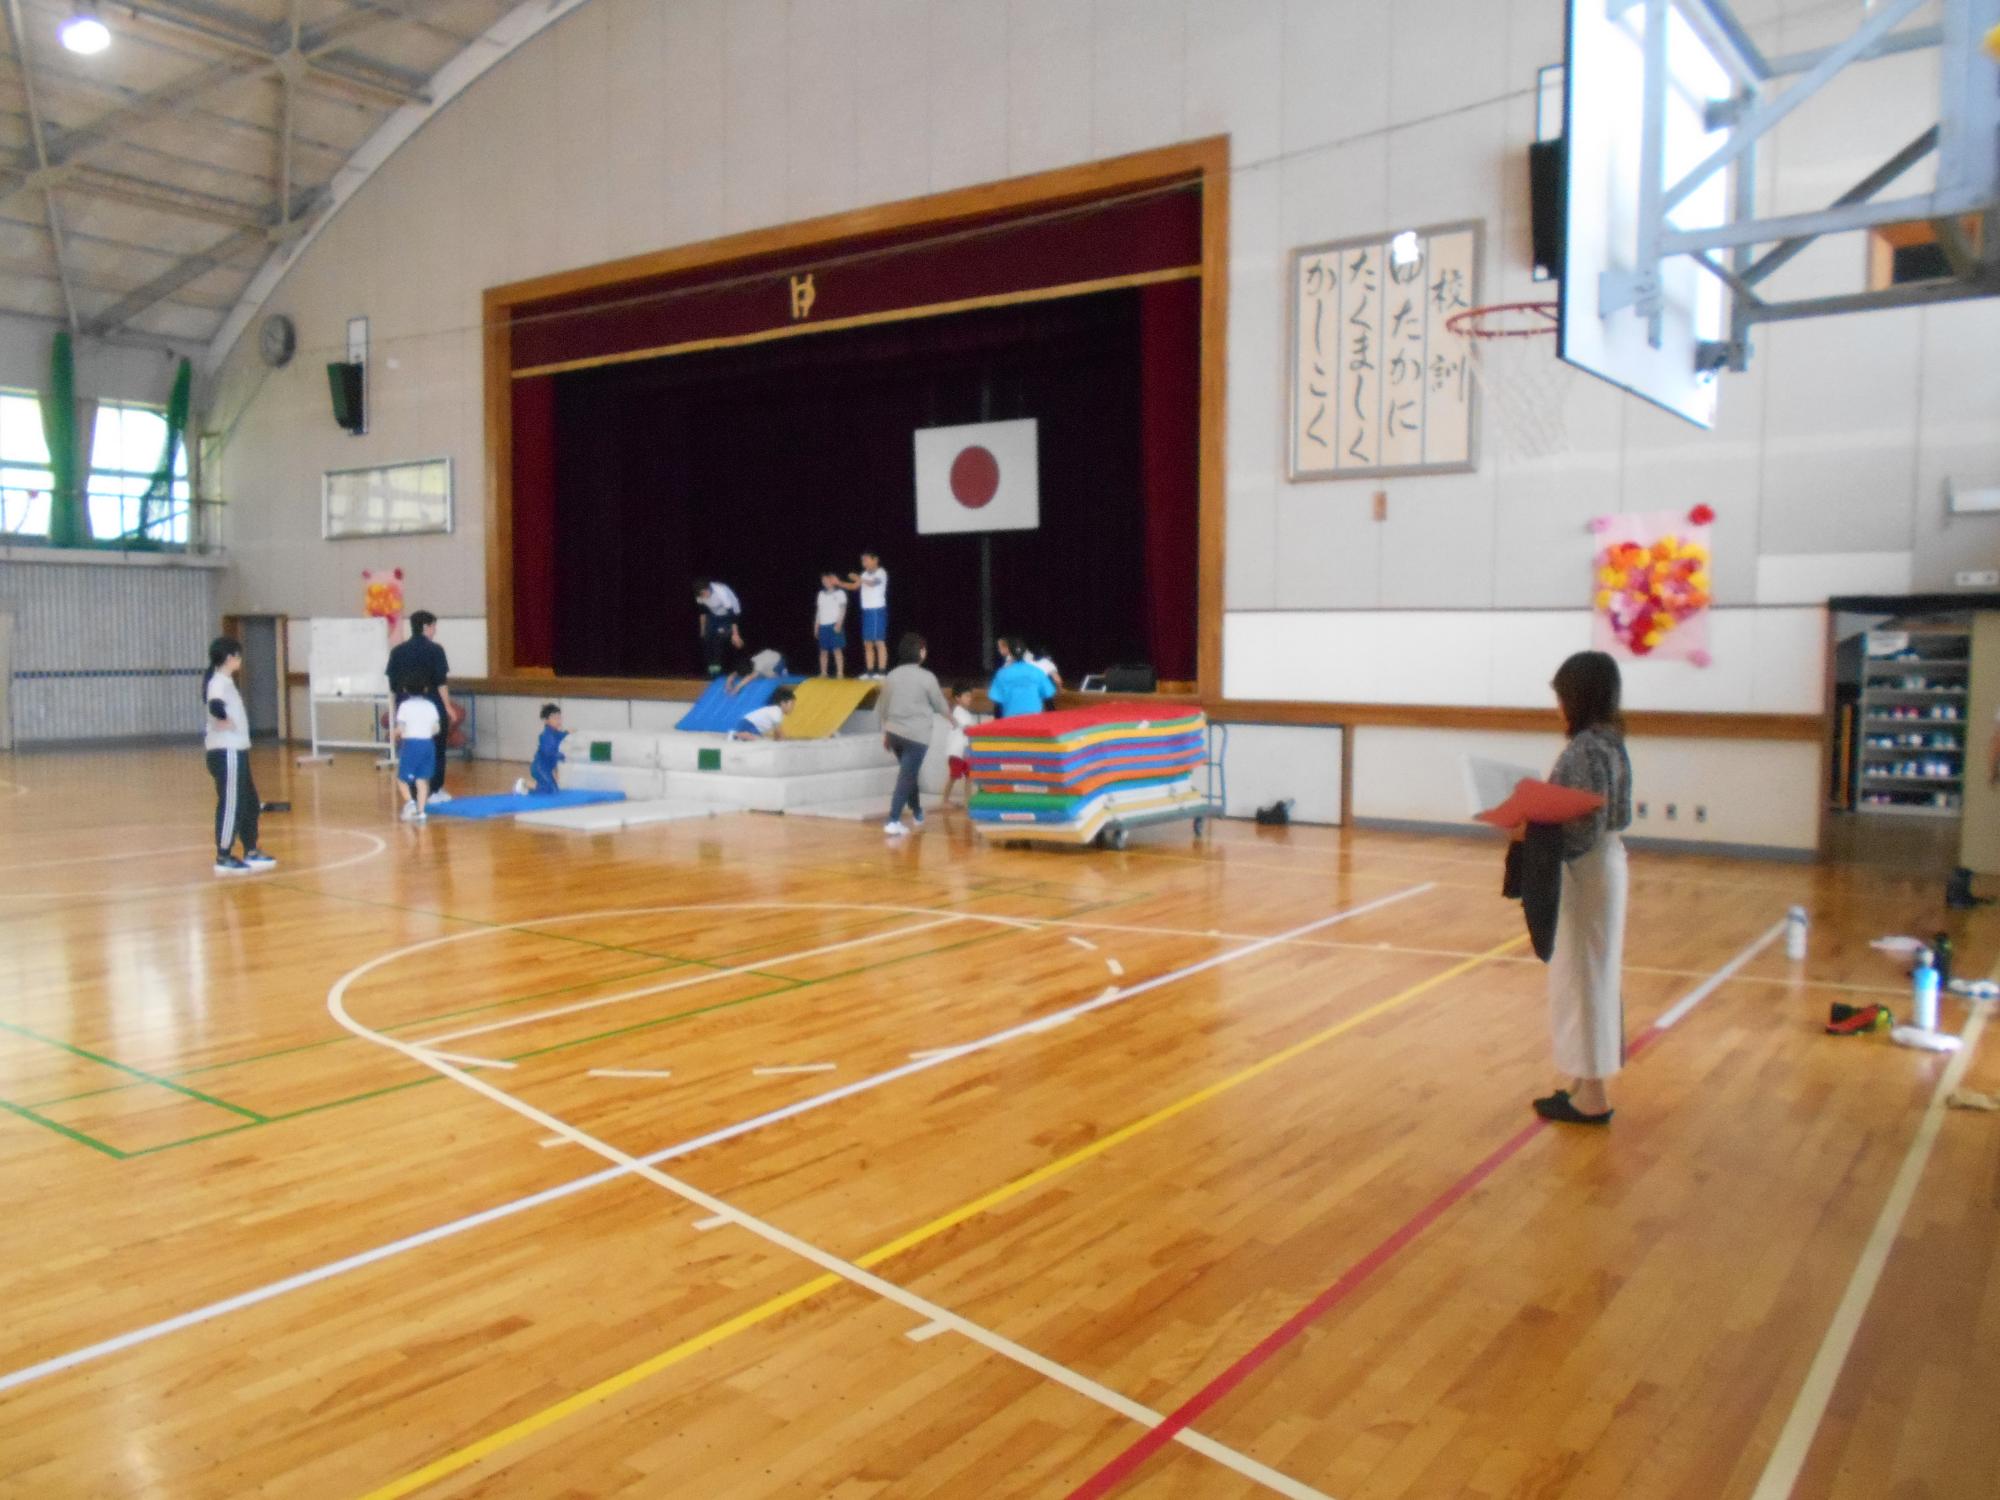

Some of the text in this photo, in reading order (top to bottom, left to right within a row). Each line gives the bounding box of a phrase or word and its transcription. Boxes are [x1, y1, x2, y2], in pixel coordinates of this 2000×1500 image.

[1305, 258, 1337, 448] かしこく
[1348, 249, 1378, 463] たくましく
